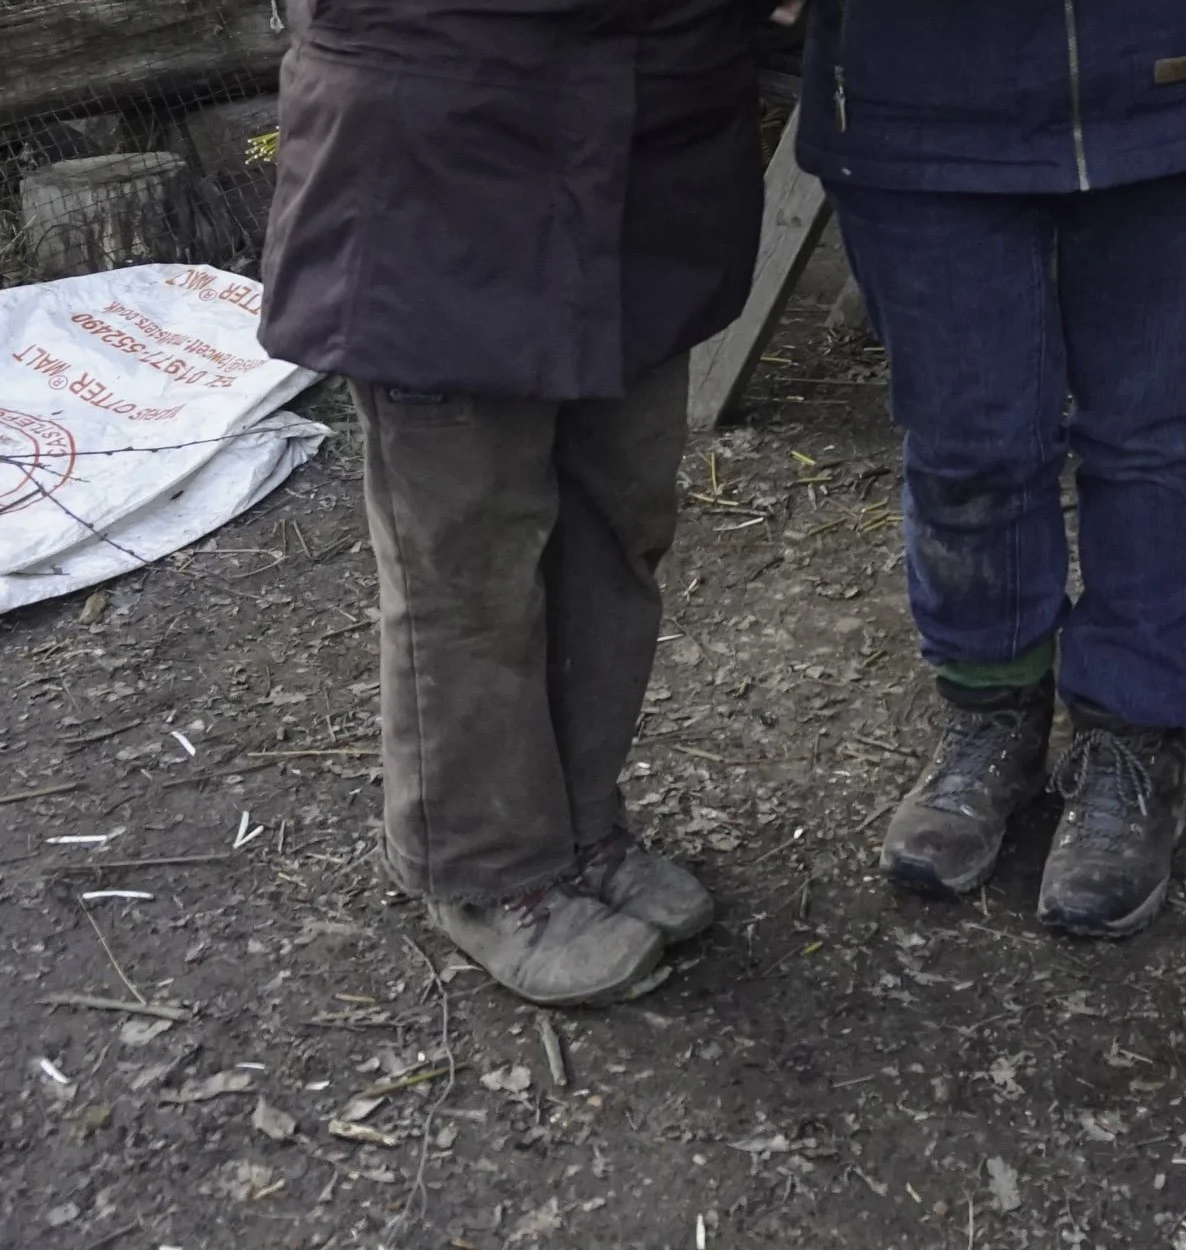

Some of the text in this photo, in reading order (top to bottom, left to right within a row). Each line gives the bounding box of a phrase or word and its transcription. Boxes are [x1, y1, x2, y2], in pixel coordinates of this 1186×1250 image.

[164, 269, 218, 290] MALT
[12, 344, 72, 376] MALT
[71, 312, 203, 385] 01977-552490
